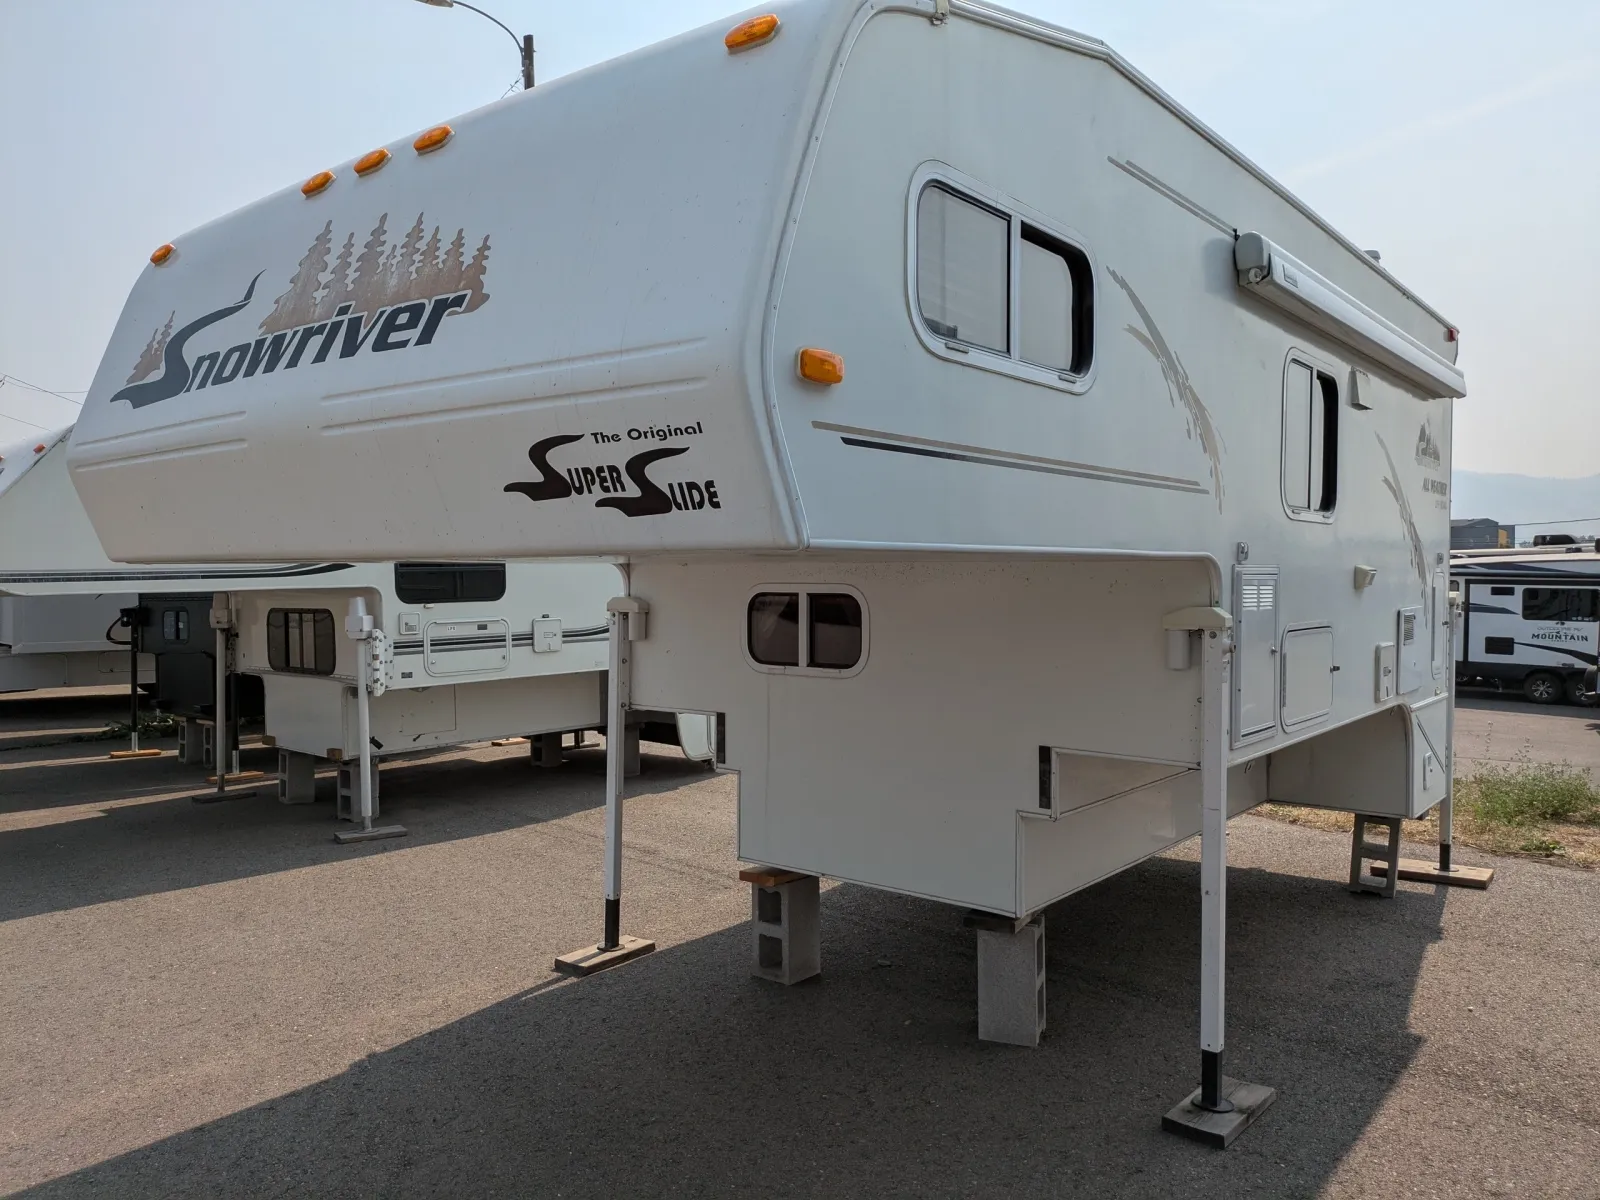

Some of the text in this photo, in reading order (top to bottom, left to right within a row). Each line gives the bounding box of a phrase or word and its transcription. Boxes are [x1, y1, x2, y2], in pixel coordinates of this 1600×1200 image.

[109, 269, 470, 409] Snowriver
[590, 421, 704, 444] The Original
[1531, 633, 1589, 642] MOUNTAIN
